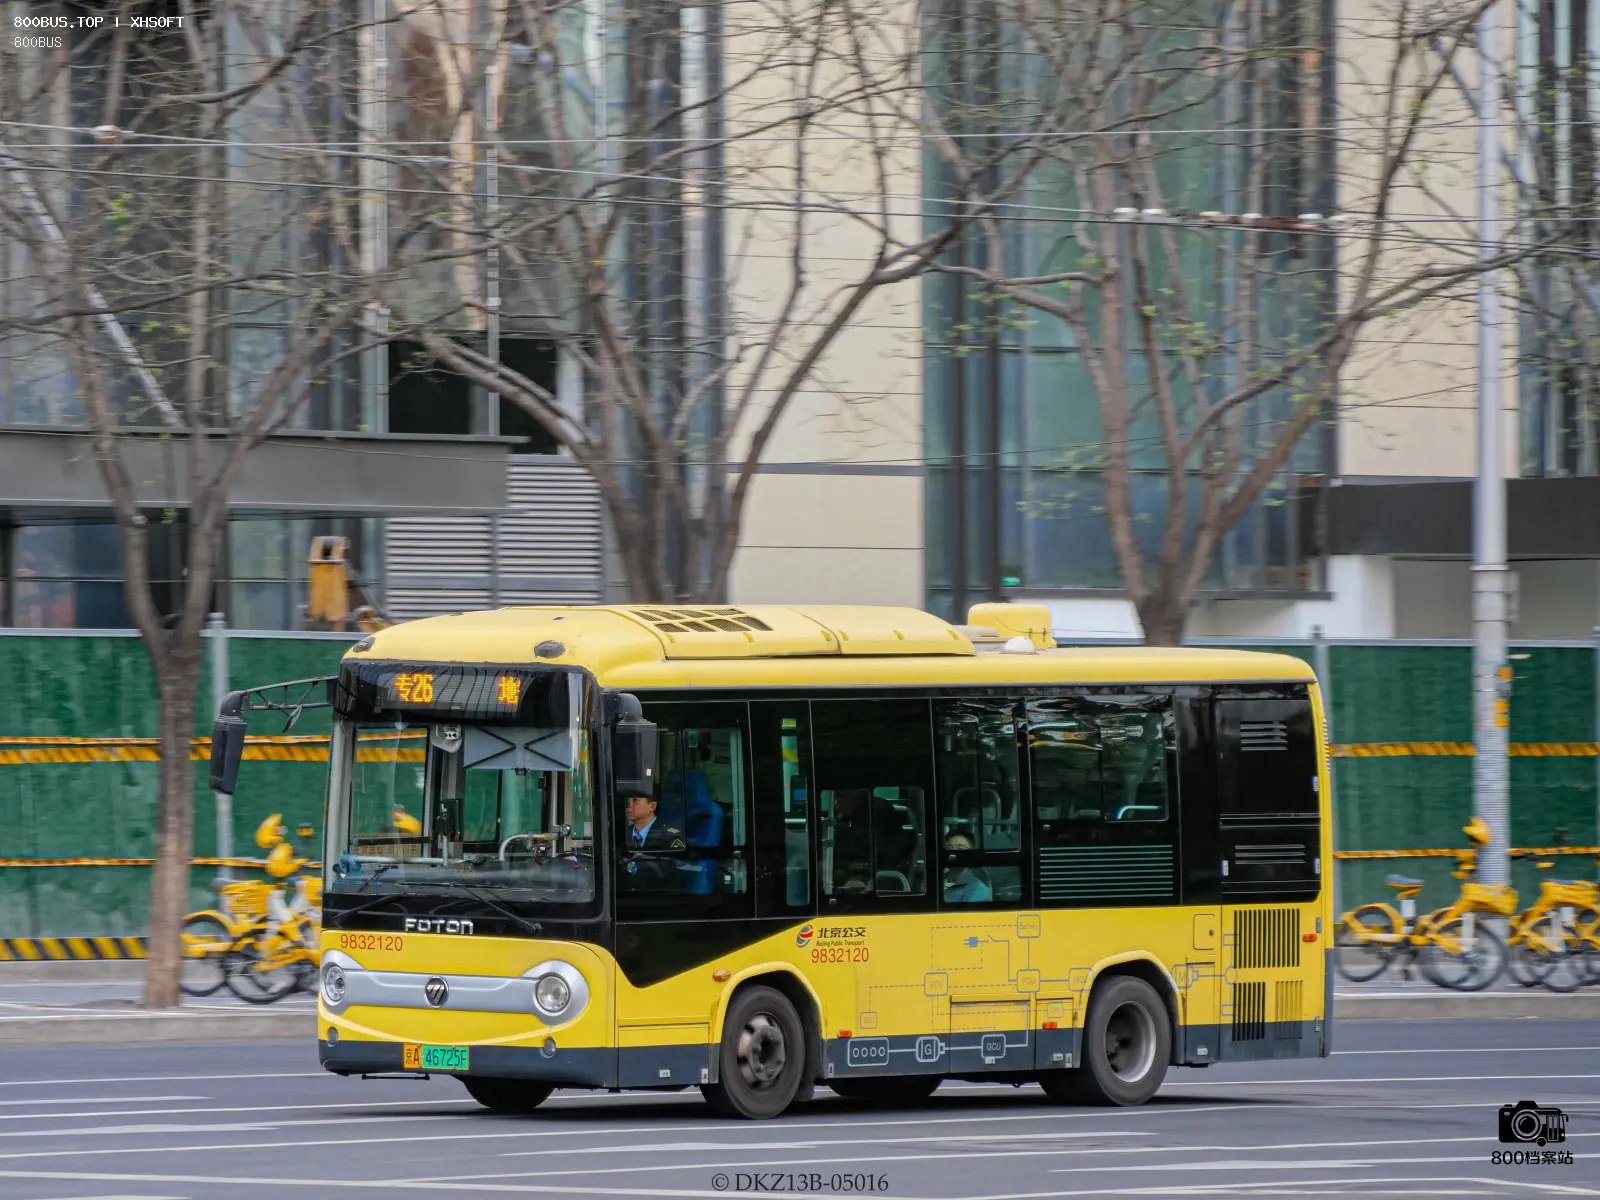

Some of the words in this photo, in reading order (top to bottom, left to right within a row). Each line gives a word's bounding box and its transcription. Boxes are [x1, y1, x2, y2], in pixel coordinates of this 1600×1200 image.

[816, 926, 867, 939] 北京公交
[340, 933, 404, 952] 9832120
[815, 940, 831, 948] Beijing
[844, 939, 865, 948] Transport
[811, 947, 870, 964] 9832120
